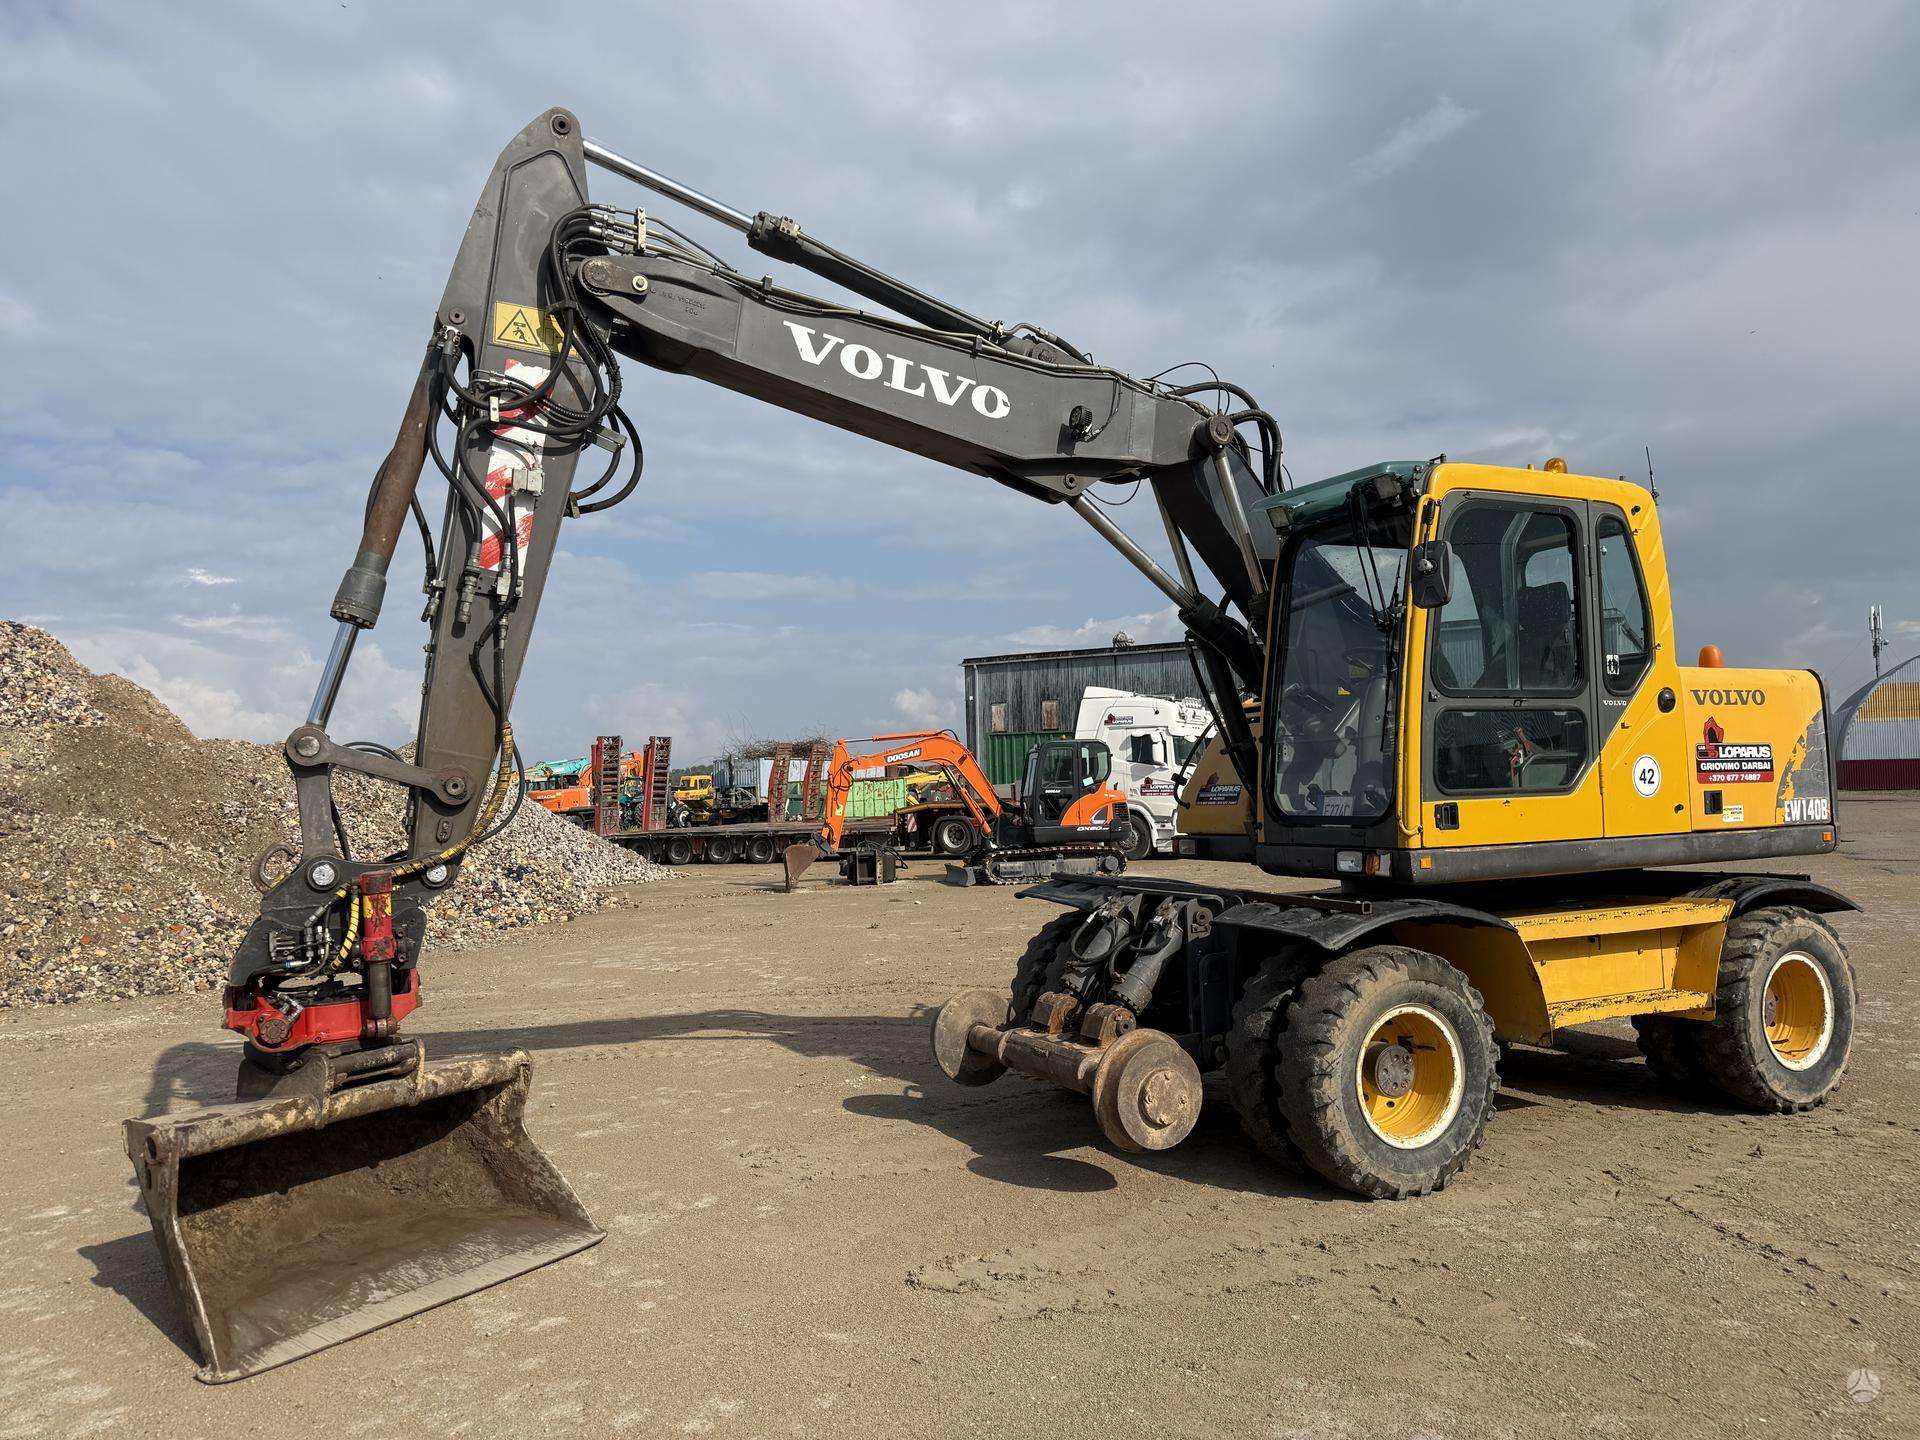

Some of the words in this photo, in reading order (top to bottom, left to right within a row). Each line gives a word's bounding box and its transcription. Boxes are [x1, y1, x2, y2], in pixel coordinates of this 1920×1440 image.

[783, 320, 1011, 419] VOLVO
[1690, 689, 1766, 706] VOLVO
[887, 749, 920, 763] DOOSAN
[1719, 746, 1771, 758] LOPARUS
[1700, 762, 1740, 771] GRIOVIMO
[1742, 761, 1771, 770] DARBAI
[1639, 768, 1655, 785] 42
[1708, 774, 1725, 782] +370
[1784, 798, 1828, 822] EW140B
